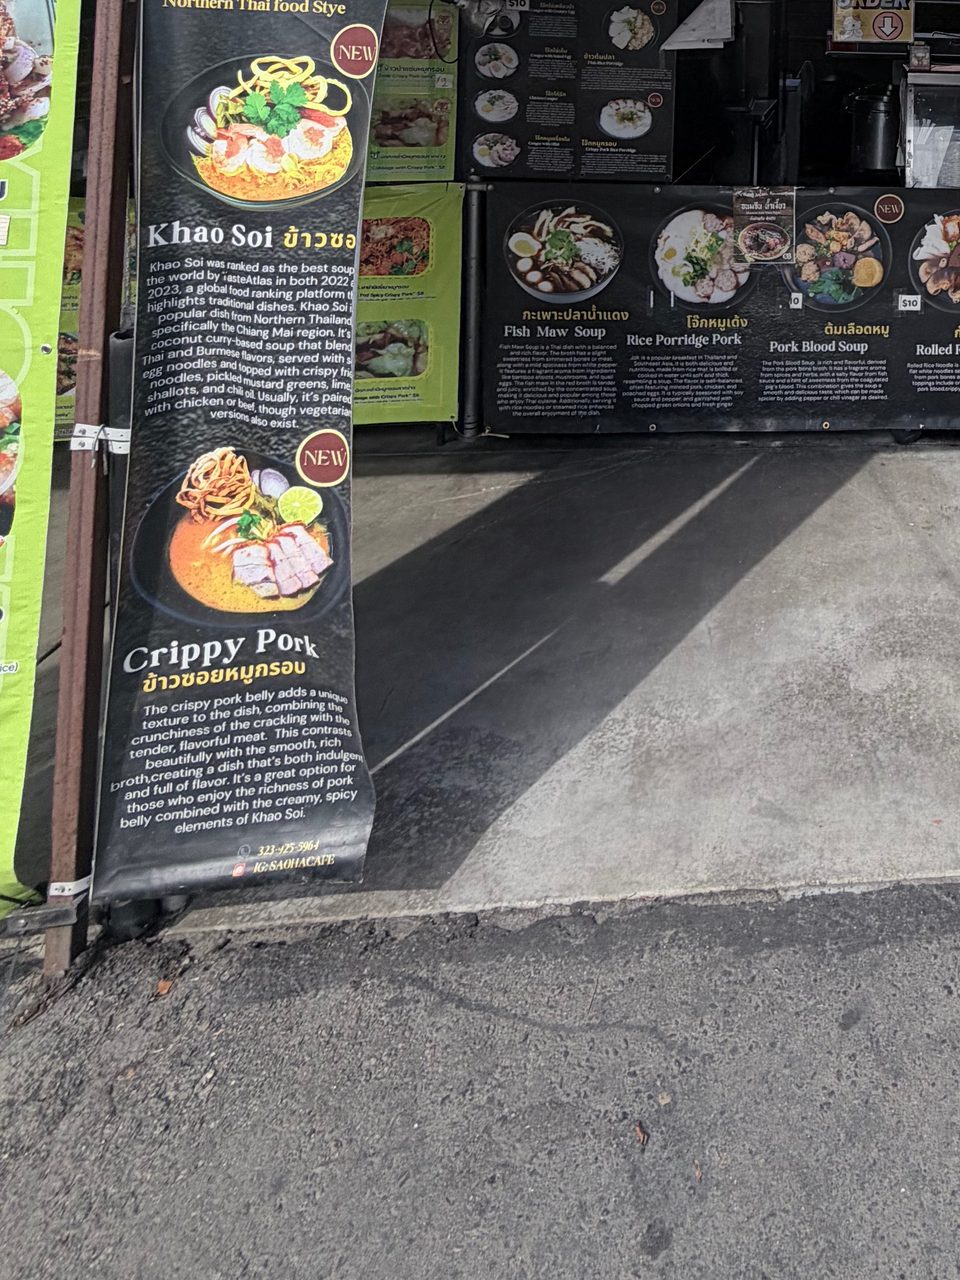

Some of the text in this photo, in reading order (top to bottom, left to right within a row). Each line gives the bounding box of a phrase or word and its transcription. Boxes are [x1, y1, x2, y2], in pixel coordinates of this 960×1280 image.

[312, 0, 346, 17] Stye
[508, 0, 526, 8] $10
[338, 45, 377, 61] NEW
[878, 204, 901, 214] NEW
[147, 220, 224, 248] Khao
[231, 224, 273, 248] Soi
[150, 260, 181, 273] Khao
[184, 258, 204, 268] Soi
[206, 260, 225, 269] was
[227, 261, 259, 273] ranked
[278, 264, 299, 273] the
[301, 263, 328, 273] best
[902, 298, 918, 308] $10
[504, 325, 606, 341] Fish Maw Soup
[626, 333, 742, 348] Rice Porridge Pork
[769, 340, 868, 356] Pork Blood Soup
[916, 343, 953, 356] Rolled
[303, 448, 347, 467] NEW
[122, 628, 320, 673] Crippy Pork
[143, 659, 306, 693] ข้าวซอยหมูกรอบ
[144, 687, 348, 717] The crispy pork belly adds a unique
